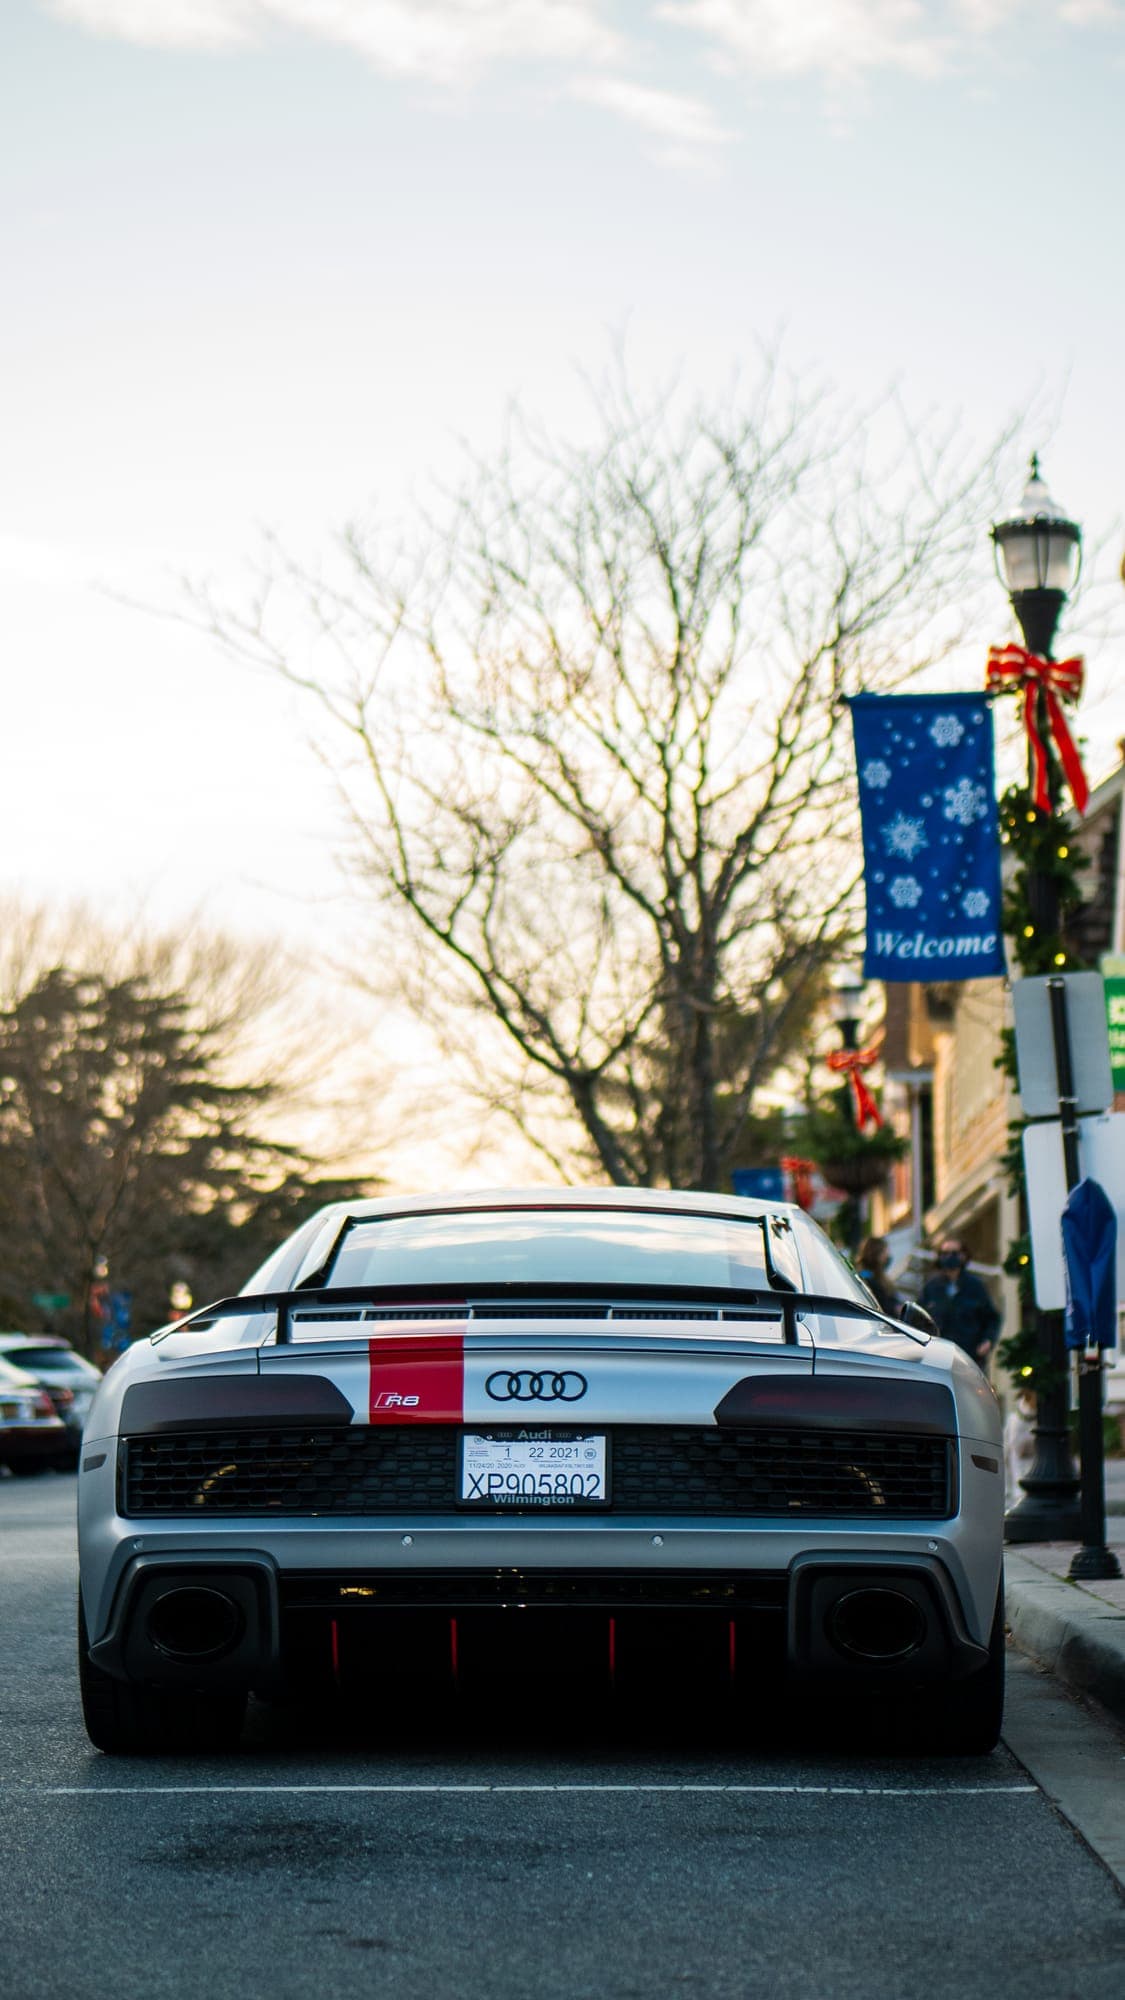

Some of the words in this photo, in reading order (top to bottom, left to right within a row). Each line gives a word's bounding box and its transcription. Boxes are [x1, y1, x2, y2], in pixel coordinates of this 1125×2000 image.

[873, 931, 997, 958] Welcome
[383, 1395, 420, 1407] R8
[518, 1429, 552, 1440] Audi
[505, 1447, 511, 1458] 1
[529, 1447, 544, 1458] 22
[550, 1447, 579, 1458] 2021
[467, 1473, 601, 1499] XP905802
[493, 1494, 575, 1506] Wilmington
